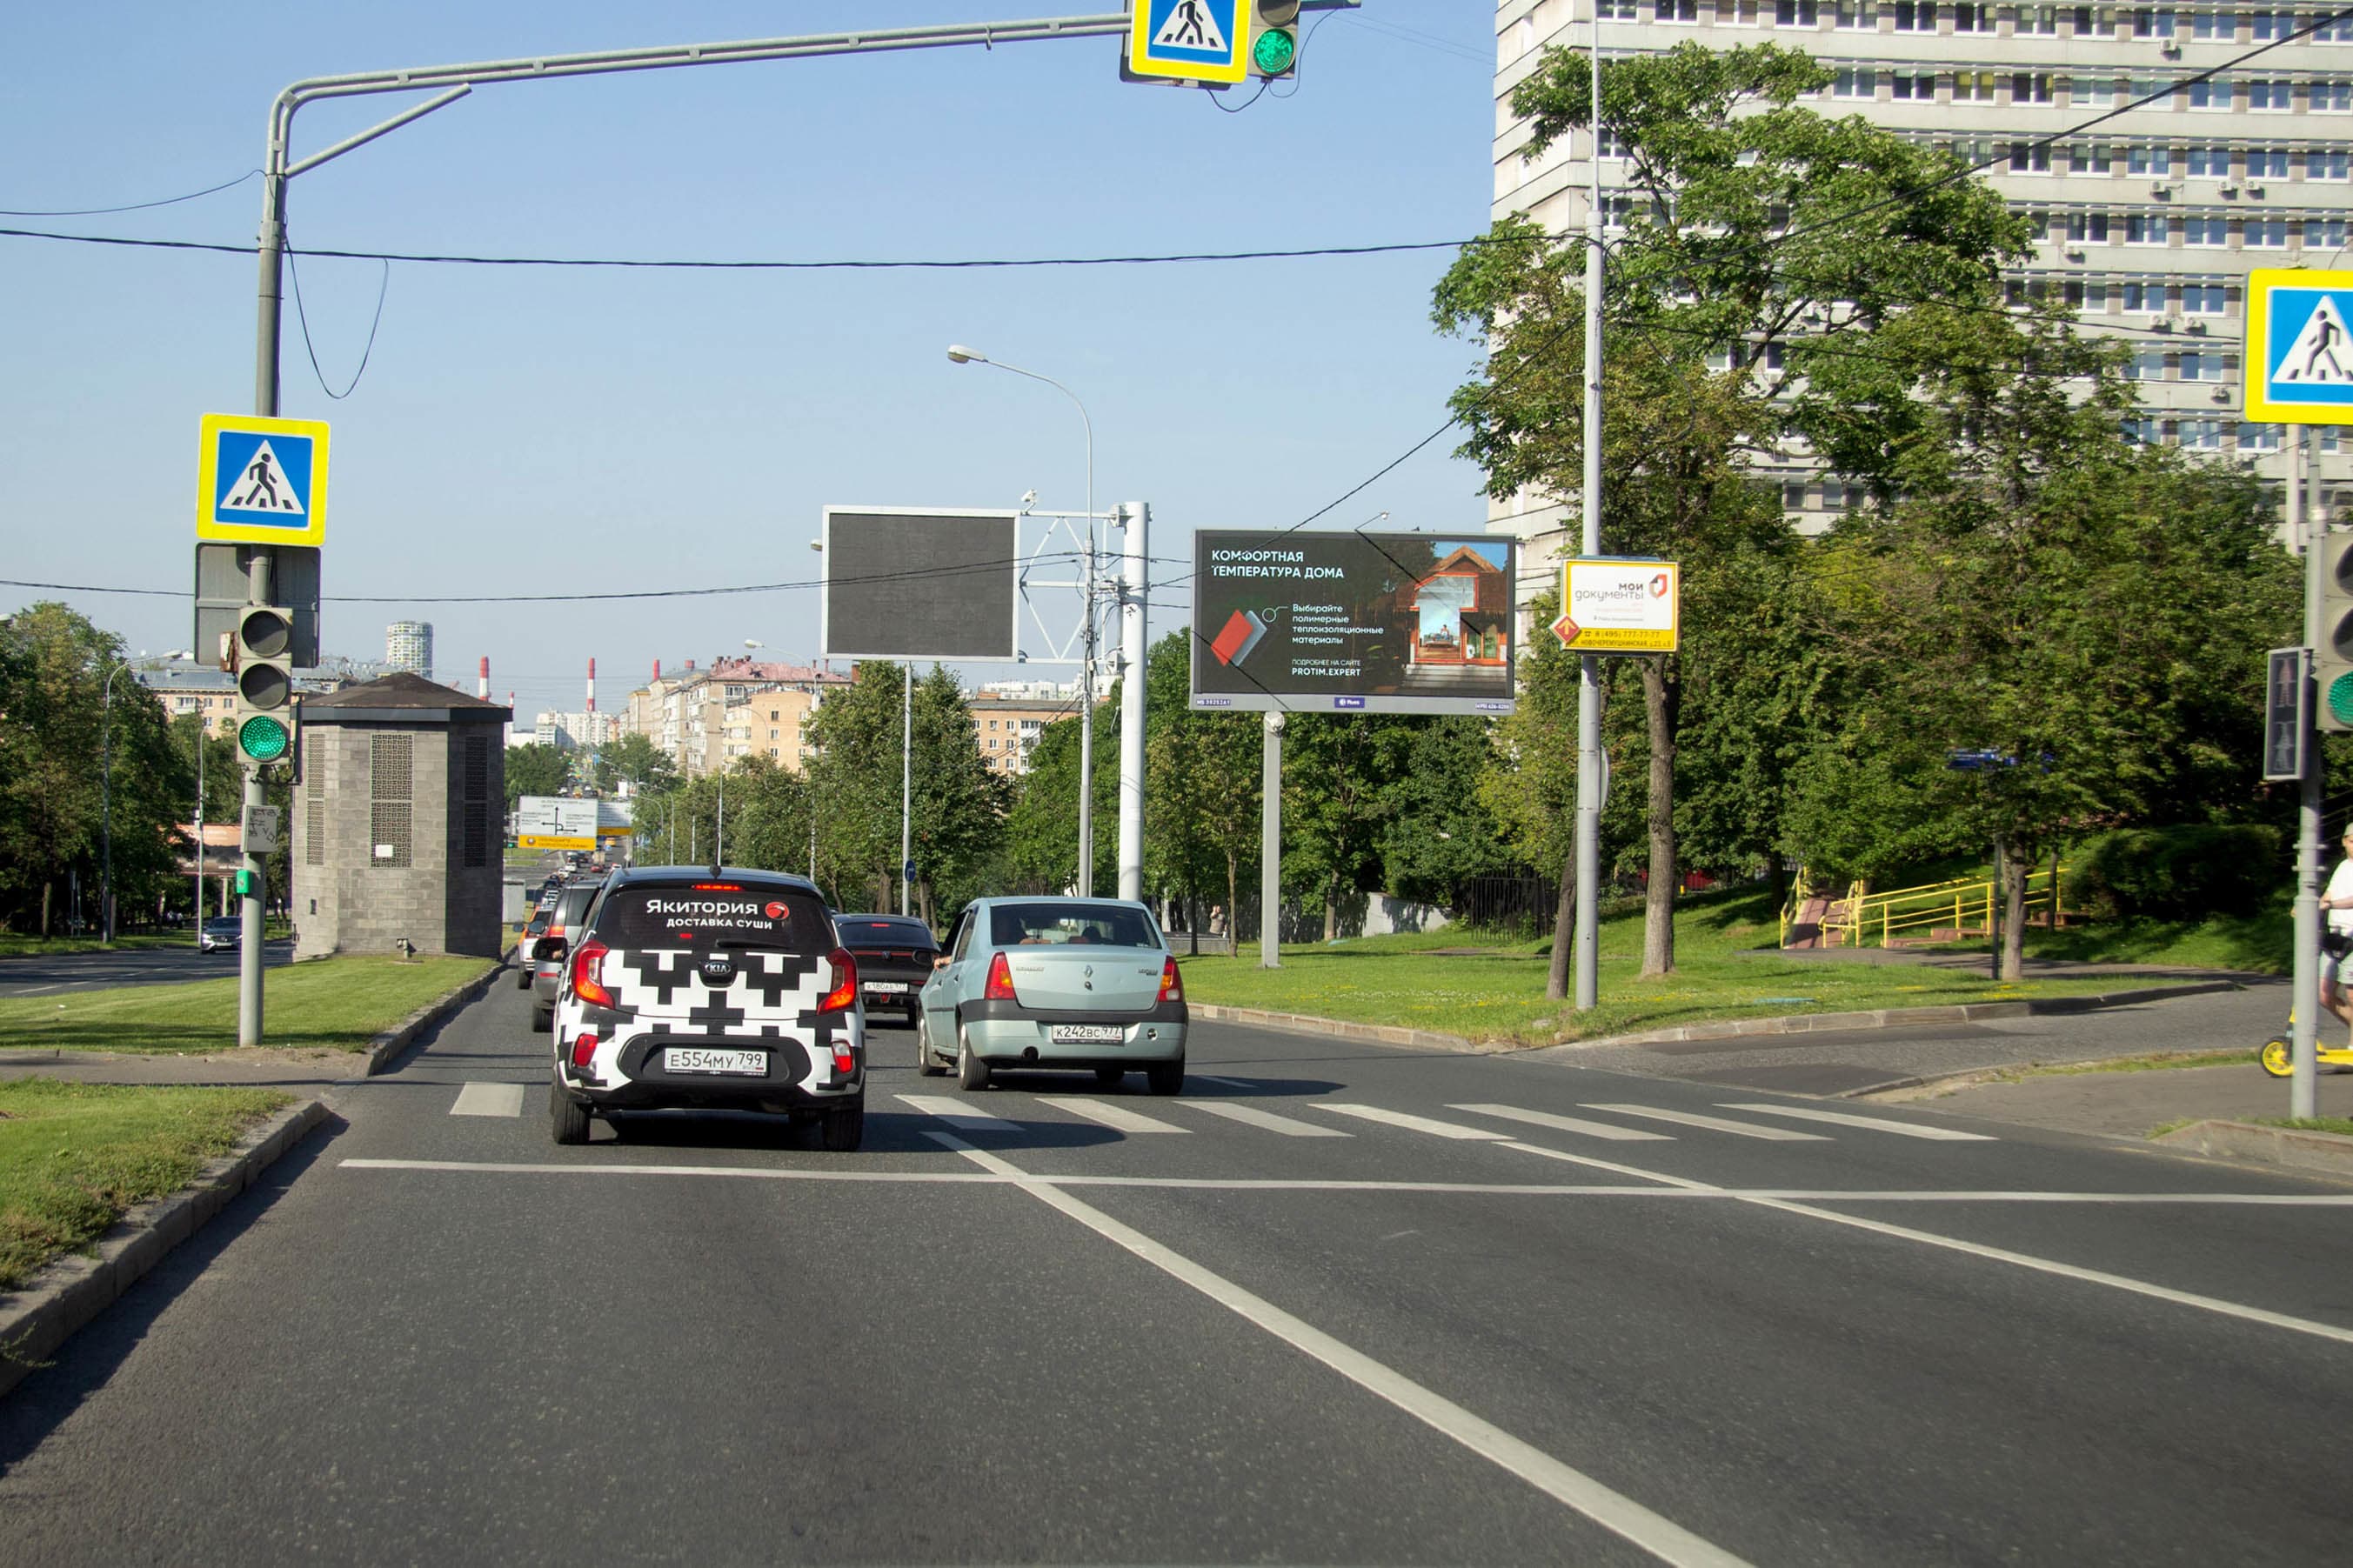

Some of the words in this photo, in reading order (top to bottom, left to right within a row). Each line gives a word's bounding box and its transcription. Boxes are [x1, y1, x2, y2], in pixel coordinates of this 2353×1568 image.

[1211, 550, 1304, 563] КОМФОРТНАЯ
[1211, 565, 1301, 577] ТЕМПЕРАТУРА
[1304, 567, 1344, 579] ДОМА
[1574, 591, 1644, 602] документы
[1293, 604, 1344, 614] Выбирайте
[1292, 616, 1349, 624] полимерные
[1292, 626, 1384, 635] теплоизоляционные
[1292, 637, 1344, 645] материалы
[1292, 667, 1361, 677] PROTIM.EXPERT
[646, 899, 758, 916] Якитория
[666, 917, 733, 928] ДОСТАВКА
[736, 919, 772, 930] СУШИ
[709, 963, 727, 973] KIA
[738, 1052, 763, 1065] 799
